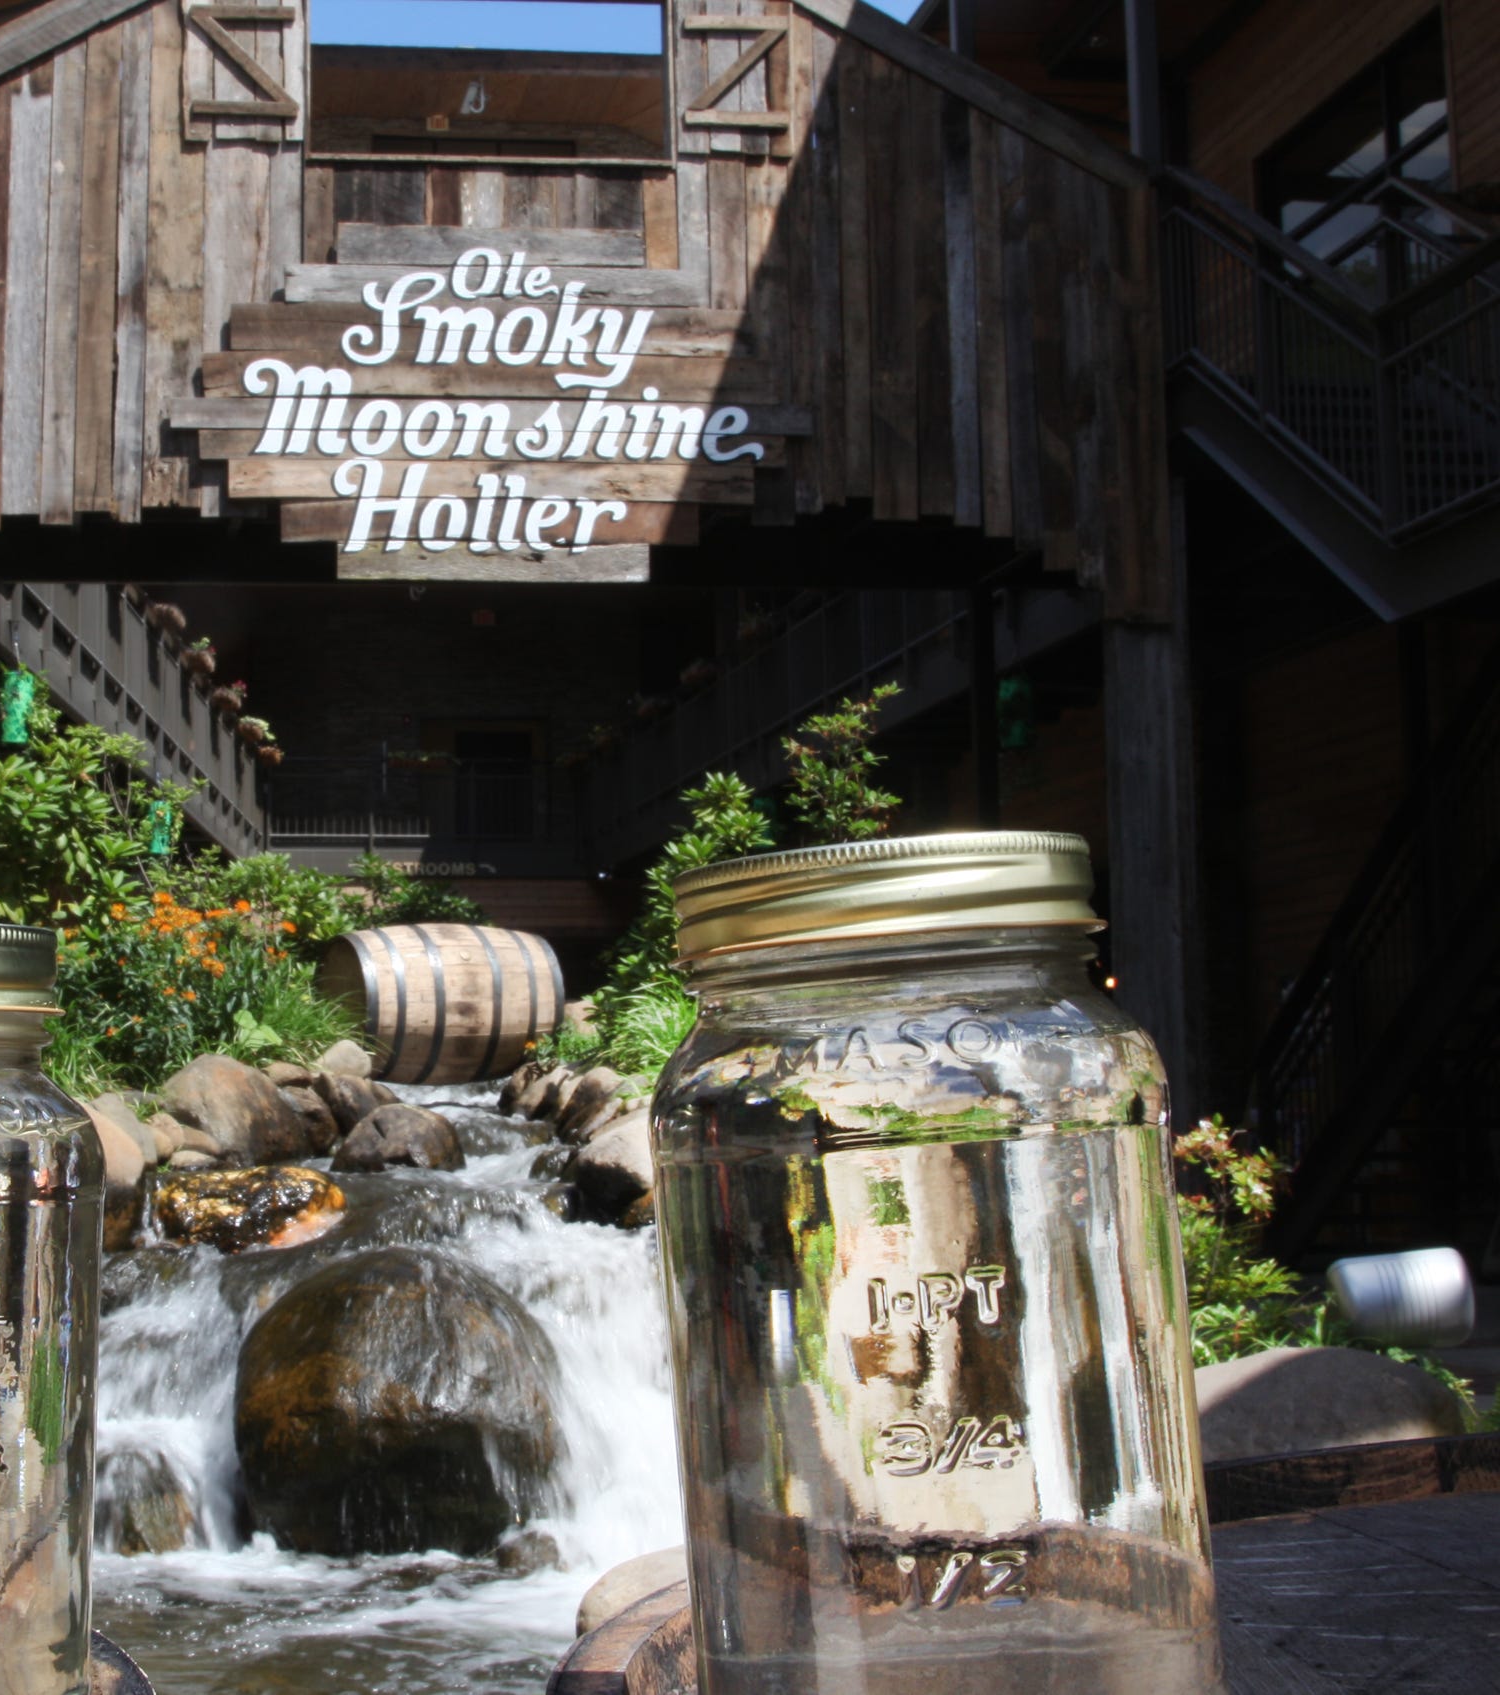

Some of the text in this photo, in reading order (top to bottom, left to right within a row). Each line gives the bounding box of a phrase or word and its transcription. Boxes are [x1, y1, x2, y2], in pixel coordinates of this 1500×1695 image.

[450, 247, 560, 300] Ole
[341, 271, 654, 391] Smoky
[242, 357, 765, 464] Moonshine
[331, 457, 628, 555] Holler
[878, 1415, 1028, 1477] 3/4
[897, 1550, 1028, 1611] 1/2
